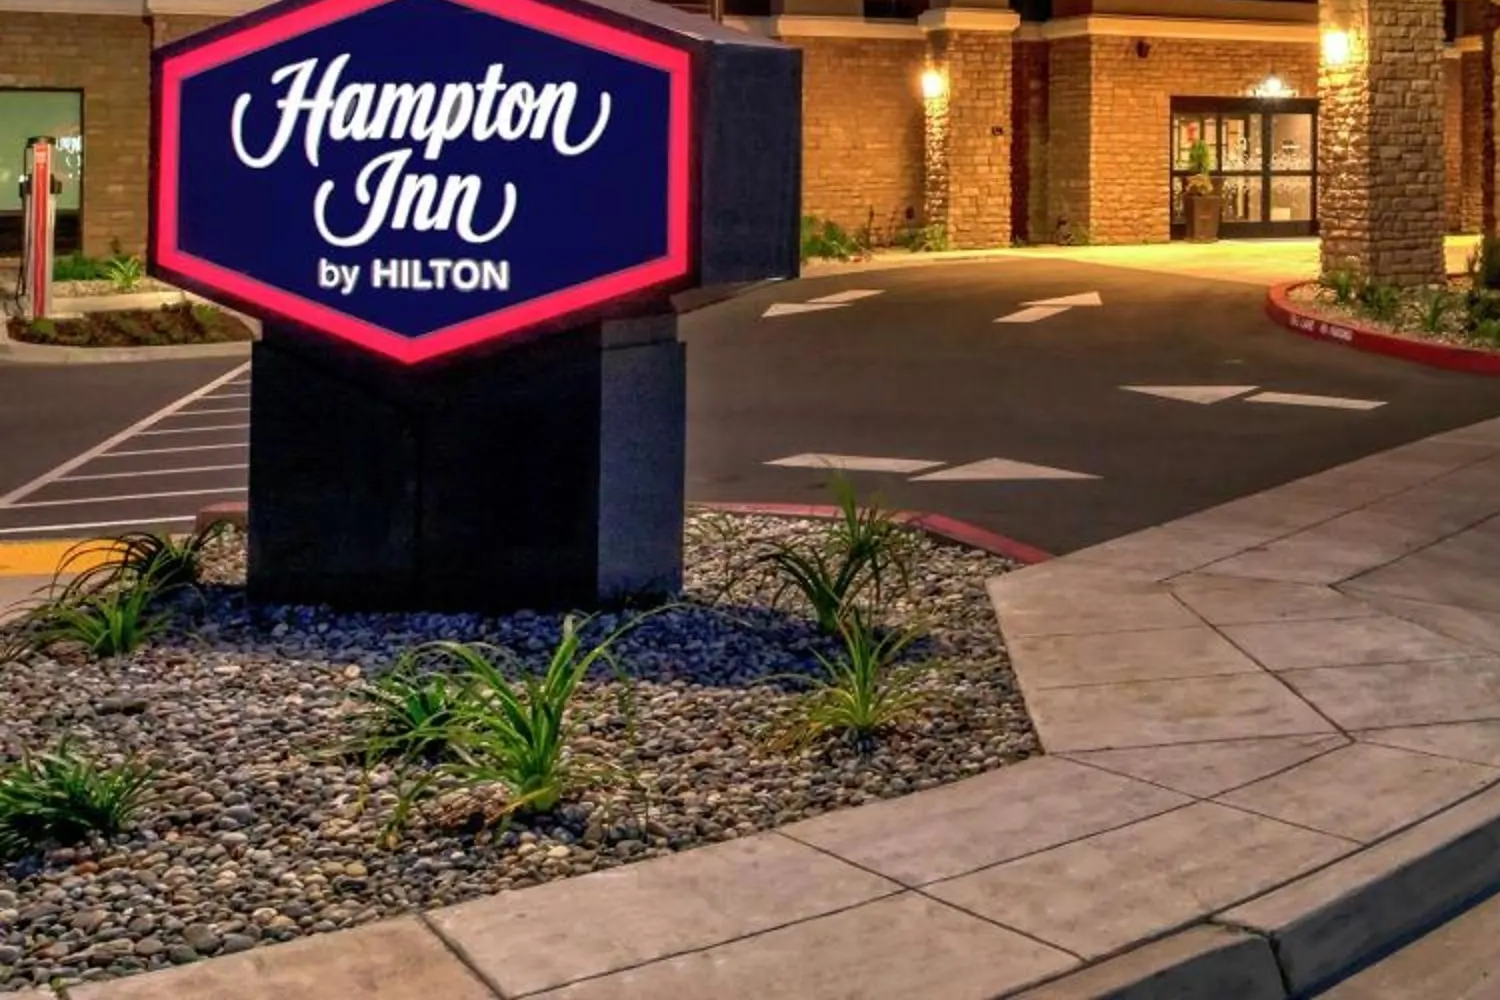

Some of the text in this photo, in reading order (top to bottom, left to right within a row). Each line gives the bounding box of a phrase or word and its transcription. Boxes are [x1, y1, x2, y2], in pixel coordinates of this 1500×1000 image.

[231, 53, 611, 169] Hampton
[314, 148, 517, 247] Inn
[319, 258, 509, 295] by HILTON
